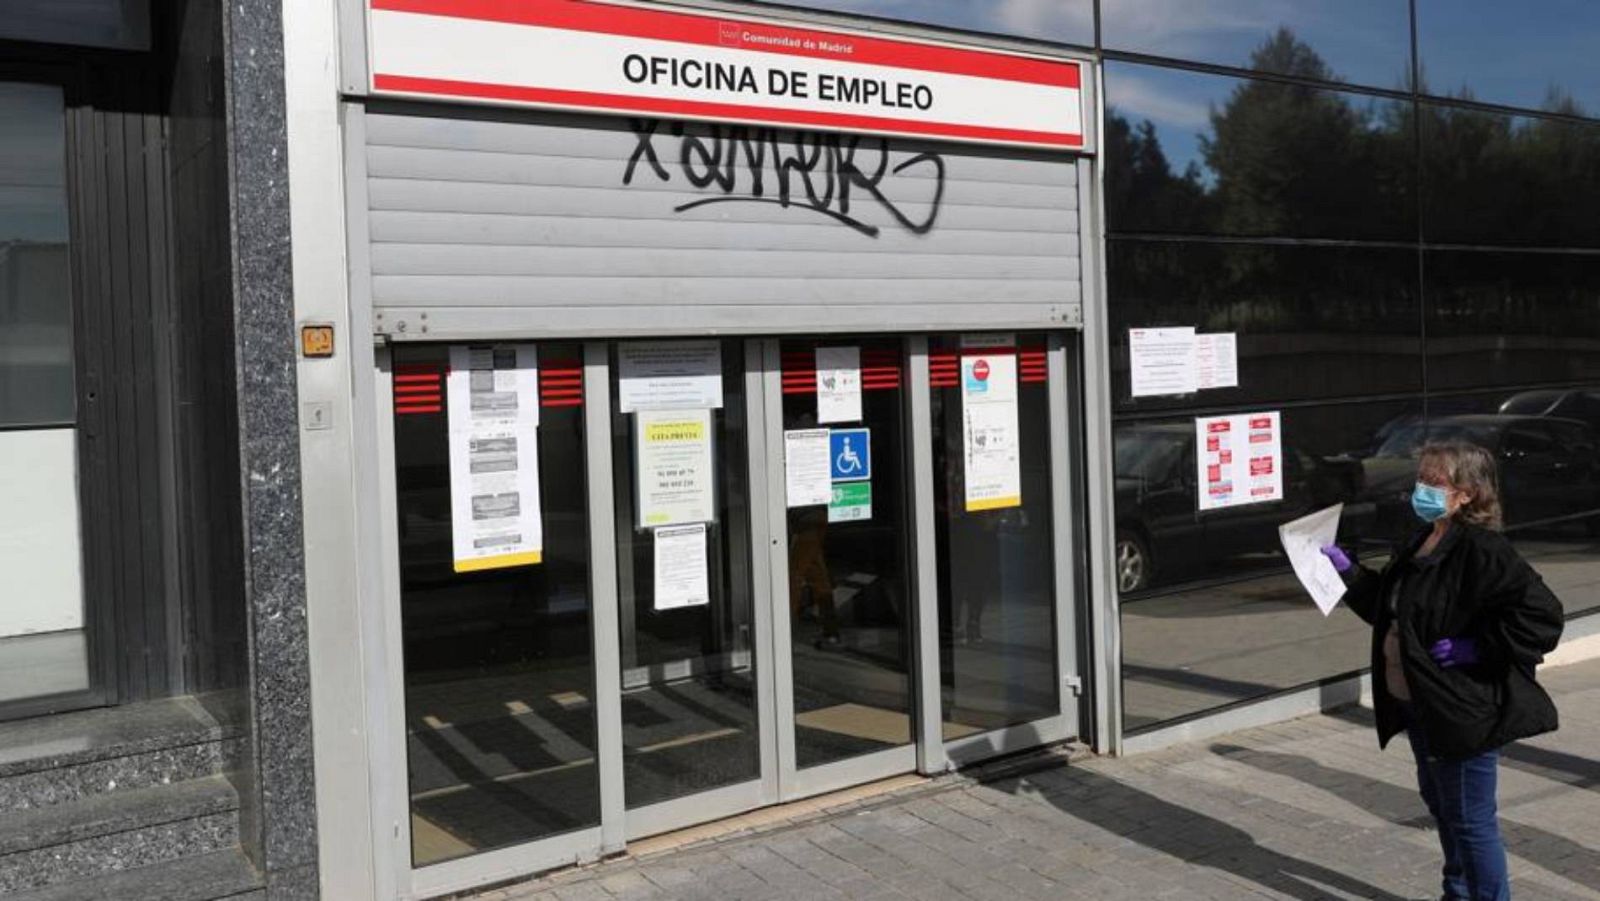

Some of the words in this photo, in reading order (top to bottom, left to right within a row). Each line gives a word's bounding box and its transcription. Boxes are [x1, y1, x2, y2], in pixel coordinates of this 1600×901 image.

[742, 31, 801, 48] Comunidad
[803, 39, 816, 50] de
[818, 41, 854, 54] Madrid
[622, 53, 759, 94] OFICINA
[768, 69, 808, 98] DE
[818, 74, 933, 111] EMPLEO
